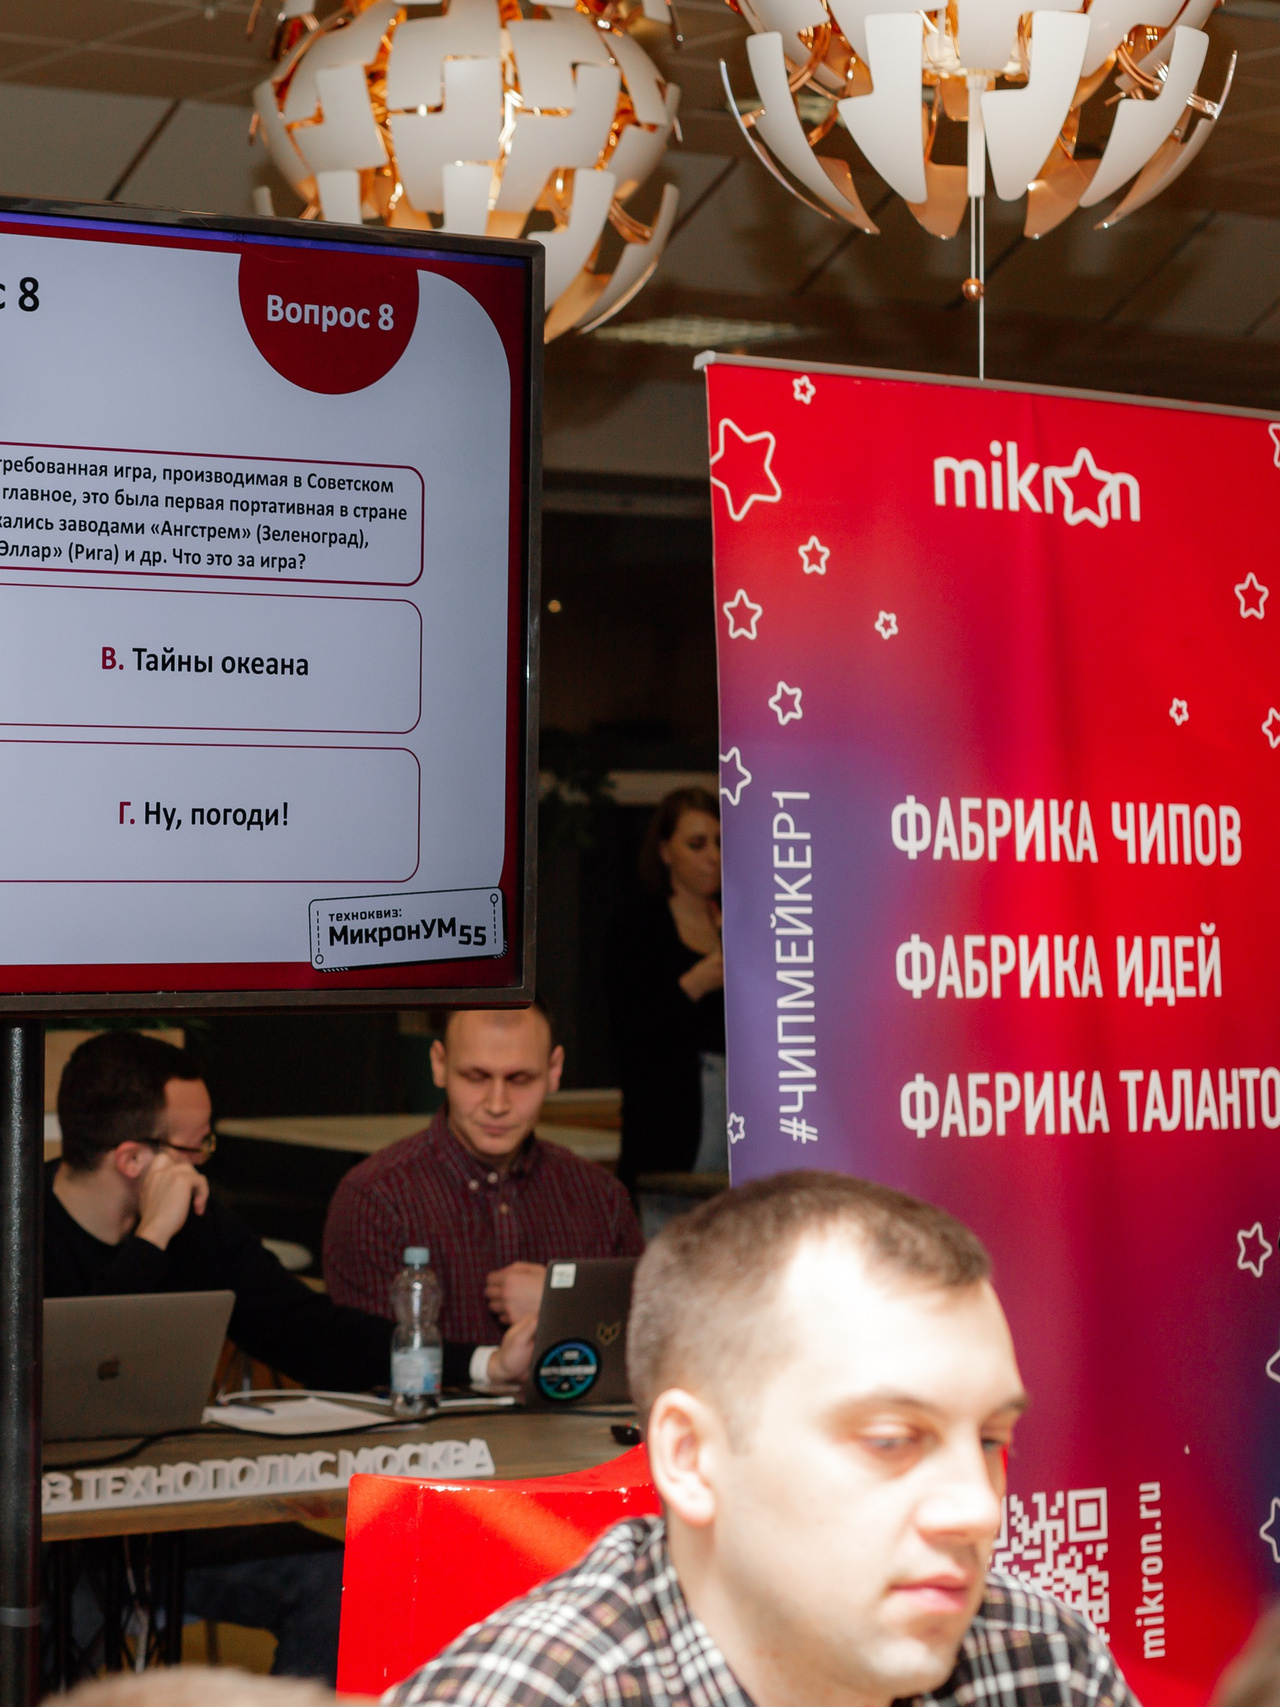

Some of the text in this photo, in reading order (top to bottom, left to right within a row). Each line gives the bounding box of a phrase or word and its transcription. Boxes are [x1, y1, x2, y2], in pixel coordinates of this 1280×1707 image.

[19, 277, 39, 311] 8
[268, 295, 394, 332] Вопрос 8
[113, 465, 157, 483] игра,
[162, 467, 288, 489] производимая
[293, 475, 303, 488] в
[306, 472, 394, 494] Советском
[2, 487, 77, 507] главное,
[82, 491, 110, 505] это
[114, 488, 159, 508] была
[164, 495, 225, 514] первая
[229, 499, 335, 517] портативная
[339, 504, 349, 518] в
[352, 505, 408, 523] стране
[58, 518, 145, 537] заводами
[150, 520, 252, 543] «Ангстрем»
[256, 523, 369, 550] (Зеленоград),
[68, 541, 119, 566] (Рига)
[124, 549, 135, 563] и
[139, 550, 168, 568] др.
[172, 547, 202, 566] Что
[206, 553, 233, 567] это
[237, 554, 255, 568] за
[260, 552, 307, 573] игра?
[101, 646, 309, 676] В. Тайны океана
[119, 801, 288, 832] Г. Ну, погоди!
[890, 795, 1242, 866] ФАБРИКА ЧИПОВ
[328, 908, 402, 922] техноквиз:
[770, 791, 819, 1144] #ЧИПМЕЙКЕР1
[895, 923, 1222, 1007] ФАБРИКА ИДЕЙ
[900, 1070, 1110, 1139] ФАБРИКА
[74, 1451, 338, 1503] ТЕХНОПОЛИС
[337, 1438, 495, 1478] МОСКВА
[1135, 1482, 1166, 1659] mikron.ru
